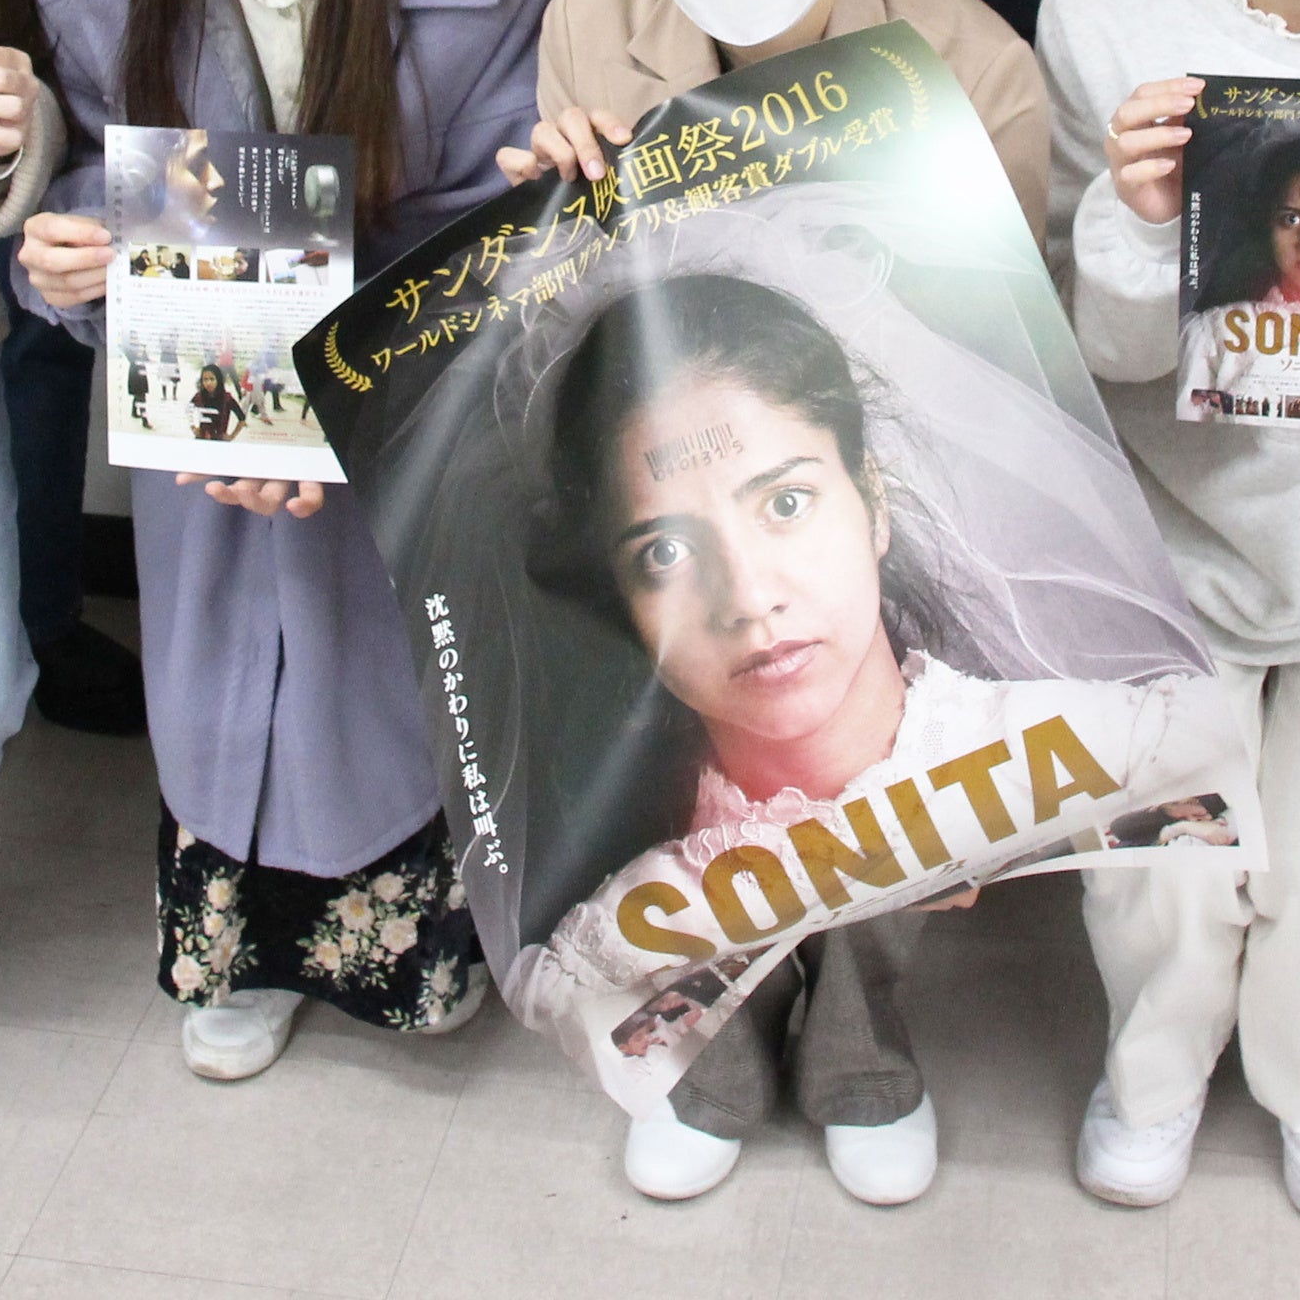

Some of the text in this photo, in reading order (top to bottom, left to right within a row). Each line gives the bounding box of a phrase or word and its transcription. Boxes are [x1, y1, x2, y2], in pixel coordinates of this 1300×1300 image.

[386, 69, 850, 324] サンダンス映画祭2016
[424, 592, 509, 875] 沈黙のかわりに私は叫ぶ。
[616, 714, 1126, 966] SONITA
